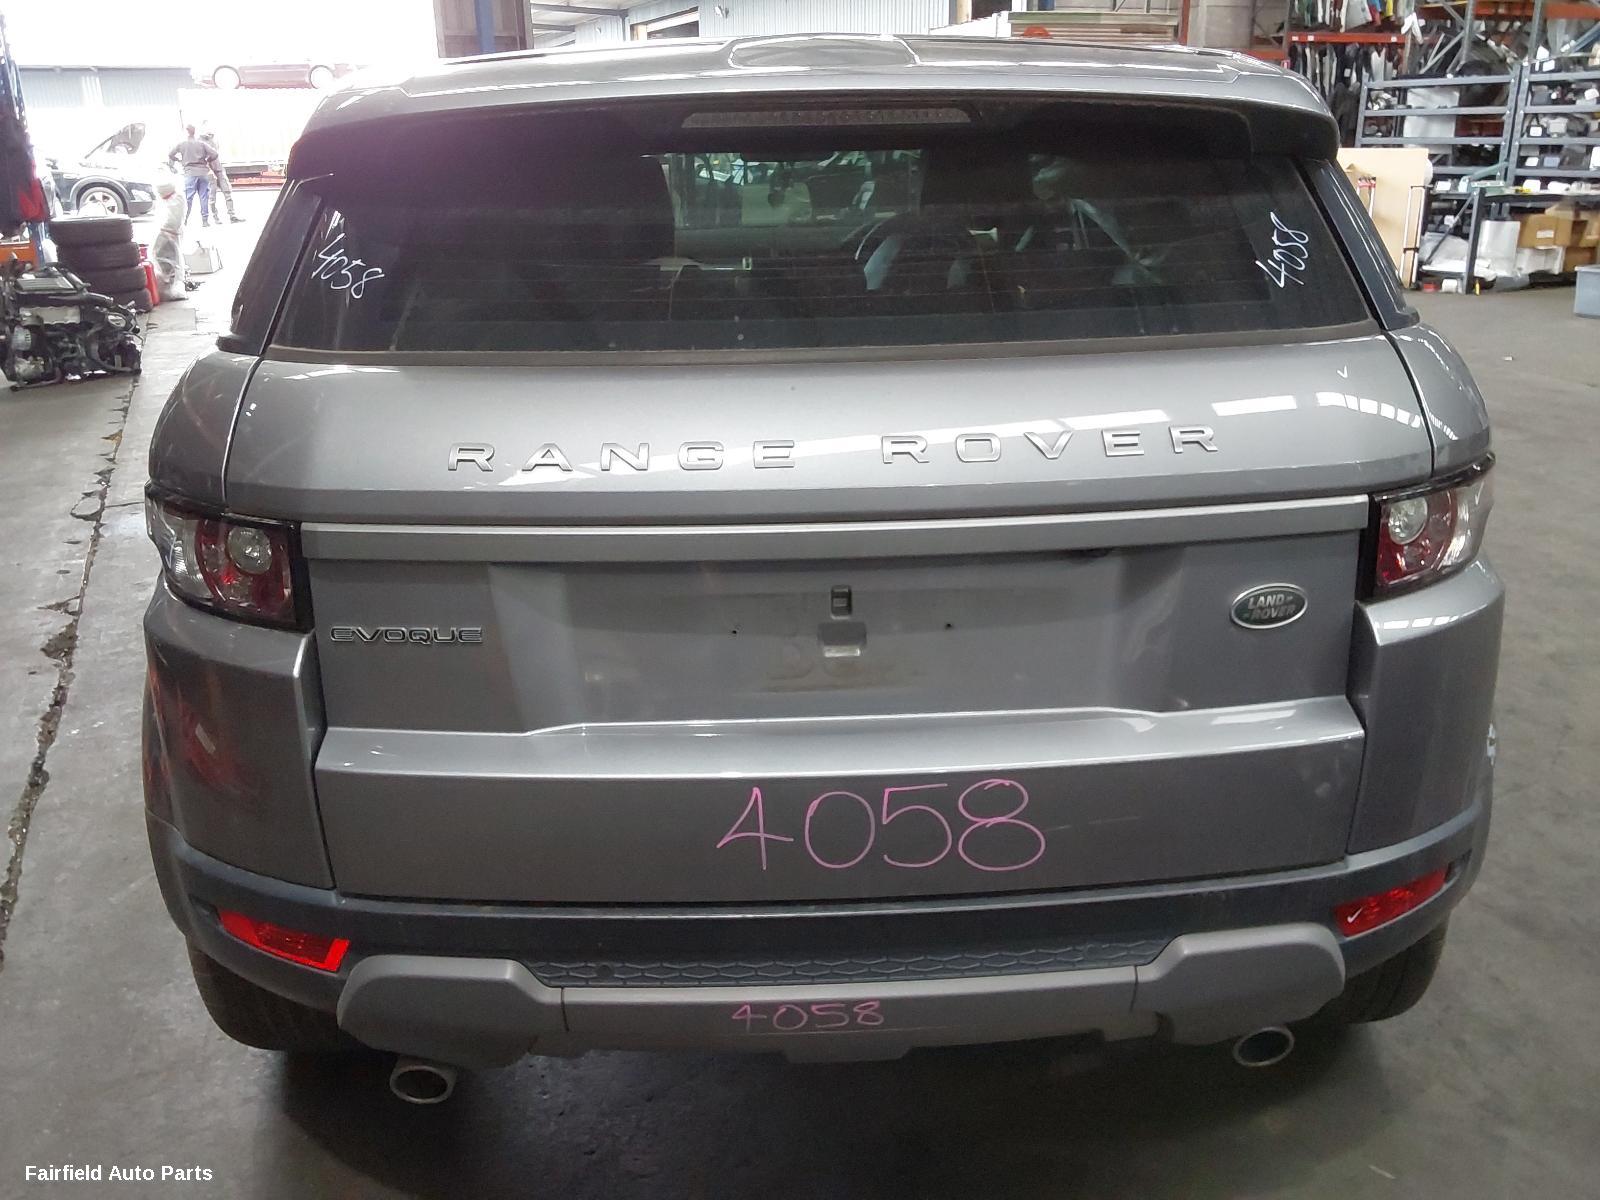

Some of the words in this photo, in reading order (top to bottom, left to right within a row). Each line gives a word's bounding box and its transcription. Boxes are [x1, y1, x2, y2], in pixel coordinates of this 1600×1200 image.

[311, 233, 385, 299] 4058
[1255, 211, 1309, 288] 4058
[447, 439, 796, 472] RANGE
[882, 424, 1219, 464] ROVER
[1247, 594, 1285, 610] LAND
[1250, 604, 1296, 620] ROVER
[330, 626, 483, 645] EVOQUE
[716, 778, 1046, 871] 4058
[732, 1000, 884, 1032] 4058
